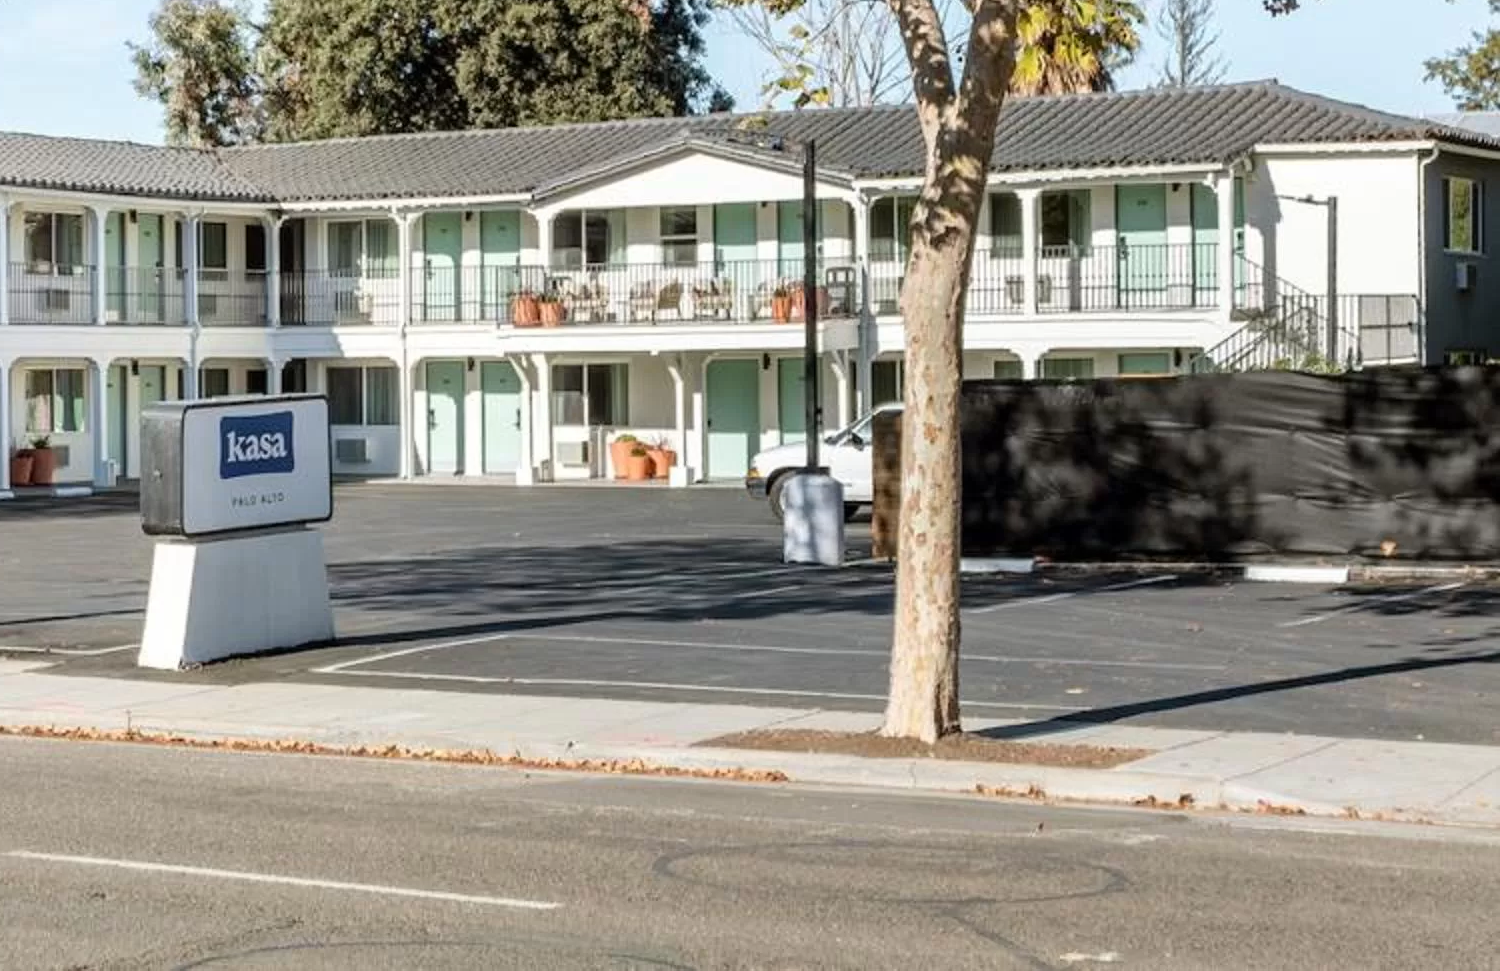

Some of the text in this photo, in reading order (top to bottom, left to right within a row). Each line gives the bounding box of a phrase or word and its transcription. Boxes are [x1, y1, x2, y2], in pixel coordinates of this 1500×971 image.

[227, 431, 288, 463] kasa
[231, 492, 285, 507] PALO ALTO
